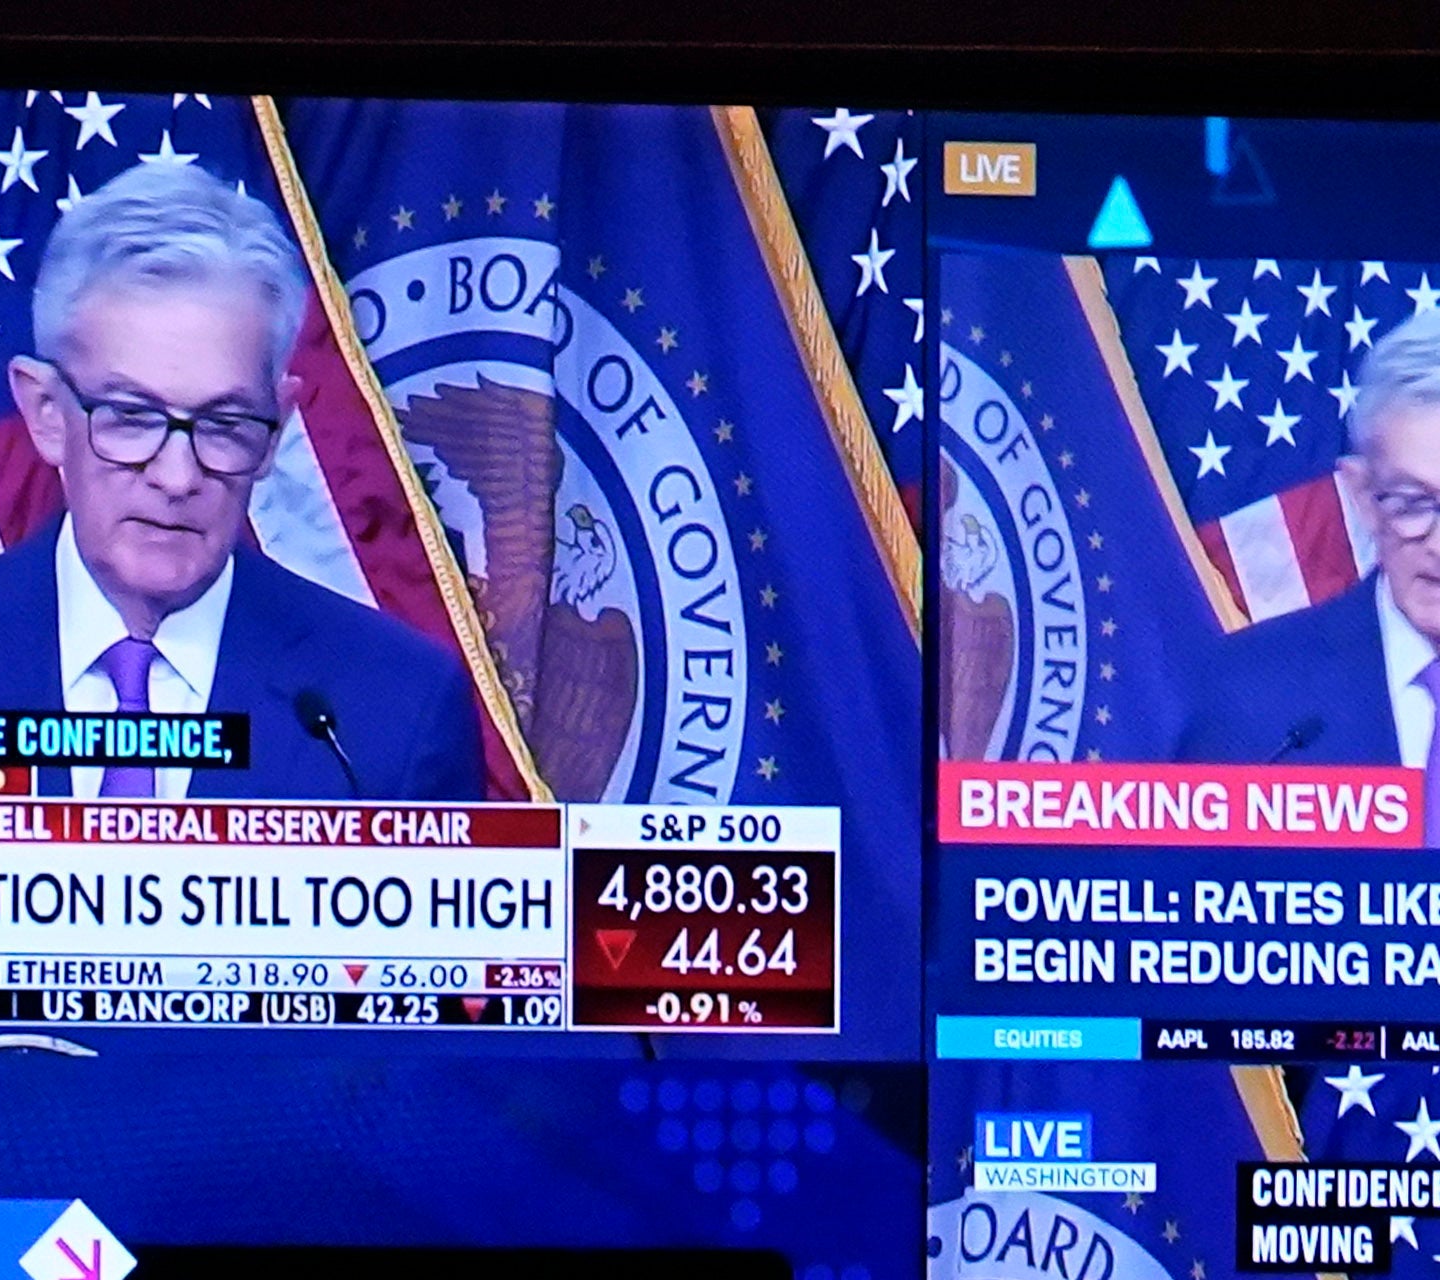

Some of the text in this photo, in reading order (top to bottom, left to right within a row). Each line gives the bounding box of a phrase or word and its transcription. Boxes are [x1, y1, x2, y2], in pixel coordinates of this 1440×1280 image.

[960, 155, 1020, 183] LIVE
[124, 874, 162, 924] IS
[181, 875, 289, 926] STILL
[307, 878, 412, 927] TOO
[431, 879, 551, 929] HIGH
[598, 866, 808, 921] 4,880.33
[974, 878, 1179, 923] POWELL:
[1195, 881, 1343, 925] RATES
[662, 929, 797, 976] 44.64
[6, 960, 163, 986] ETHEREUM
[196, 962, 328, 989] 2,318.90
[380, 965, 468, 988] 56.00
[994, 1029, 1082, 1048] EQUITIES
[1158, 1029, 1207, 1049] AAPL
[1231, 1029, 1294, 1050] 185.82
[984, 1121, 1083, 1158] LIVE
[984, 1166, 1147, 1189] WASHINGTON
